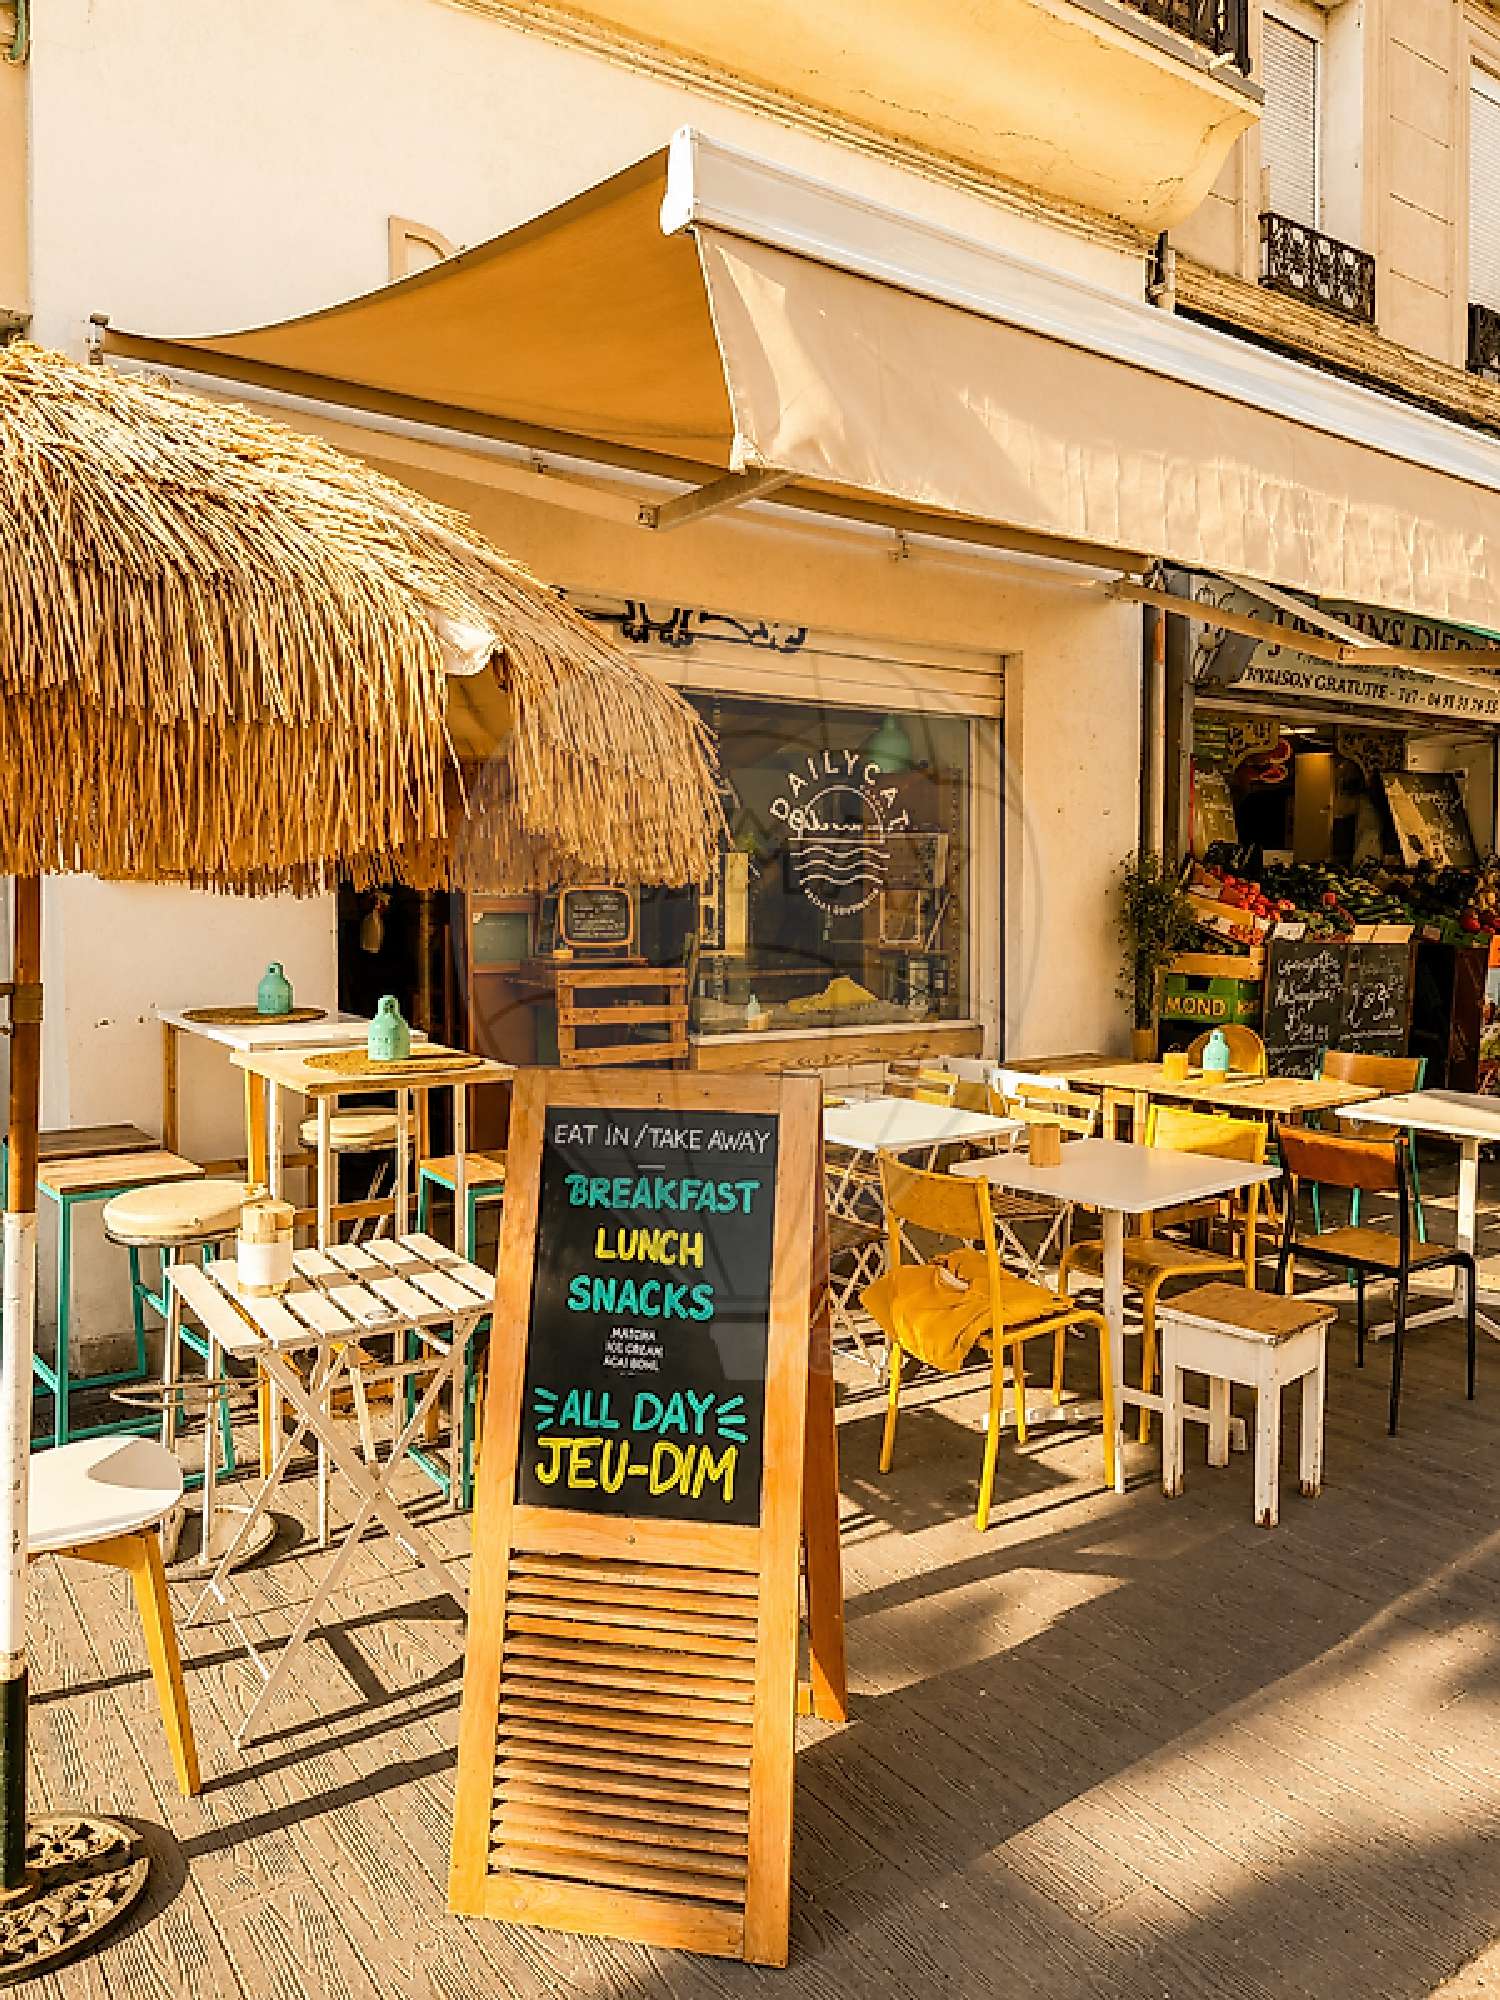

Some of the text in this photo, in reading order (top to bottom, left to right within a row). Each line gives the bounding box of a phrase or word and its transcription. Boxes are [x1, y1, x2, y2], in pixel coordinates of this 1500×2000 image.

[1315, 675, 1388, 699] GRATUITE
[554, 1124, 599, 1145] EAT
[605, 1122, 629, 1146] IN
[707, 1129, 771, 1154] AWAY
[564, 1174, 761, 1215] BREAKFAST
[594, 1226, 704, 1269] LUNCH
[567, 1274, 715, 1321] SNACKS
[625, 1342, 664, 1359] CREAM
[560, 1388, 716, 1436] ALL DAY
[534, 1436, 739, 1505] JEU-DIM
